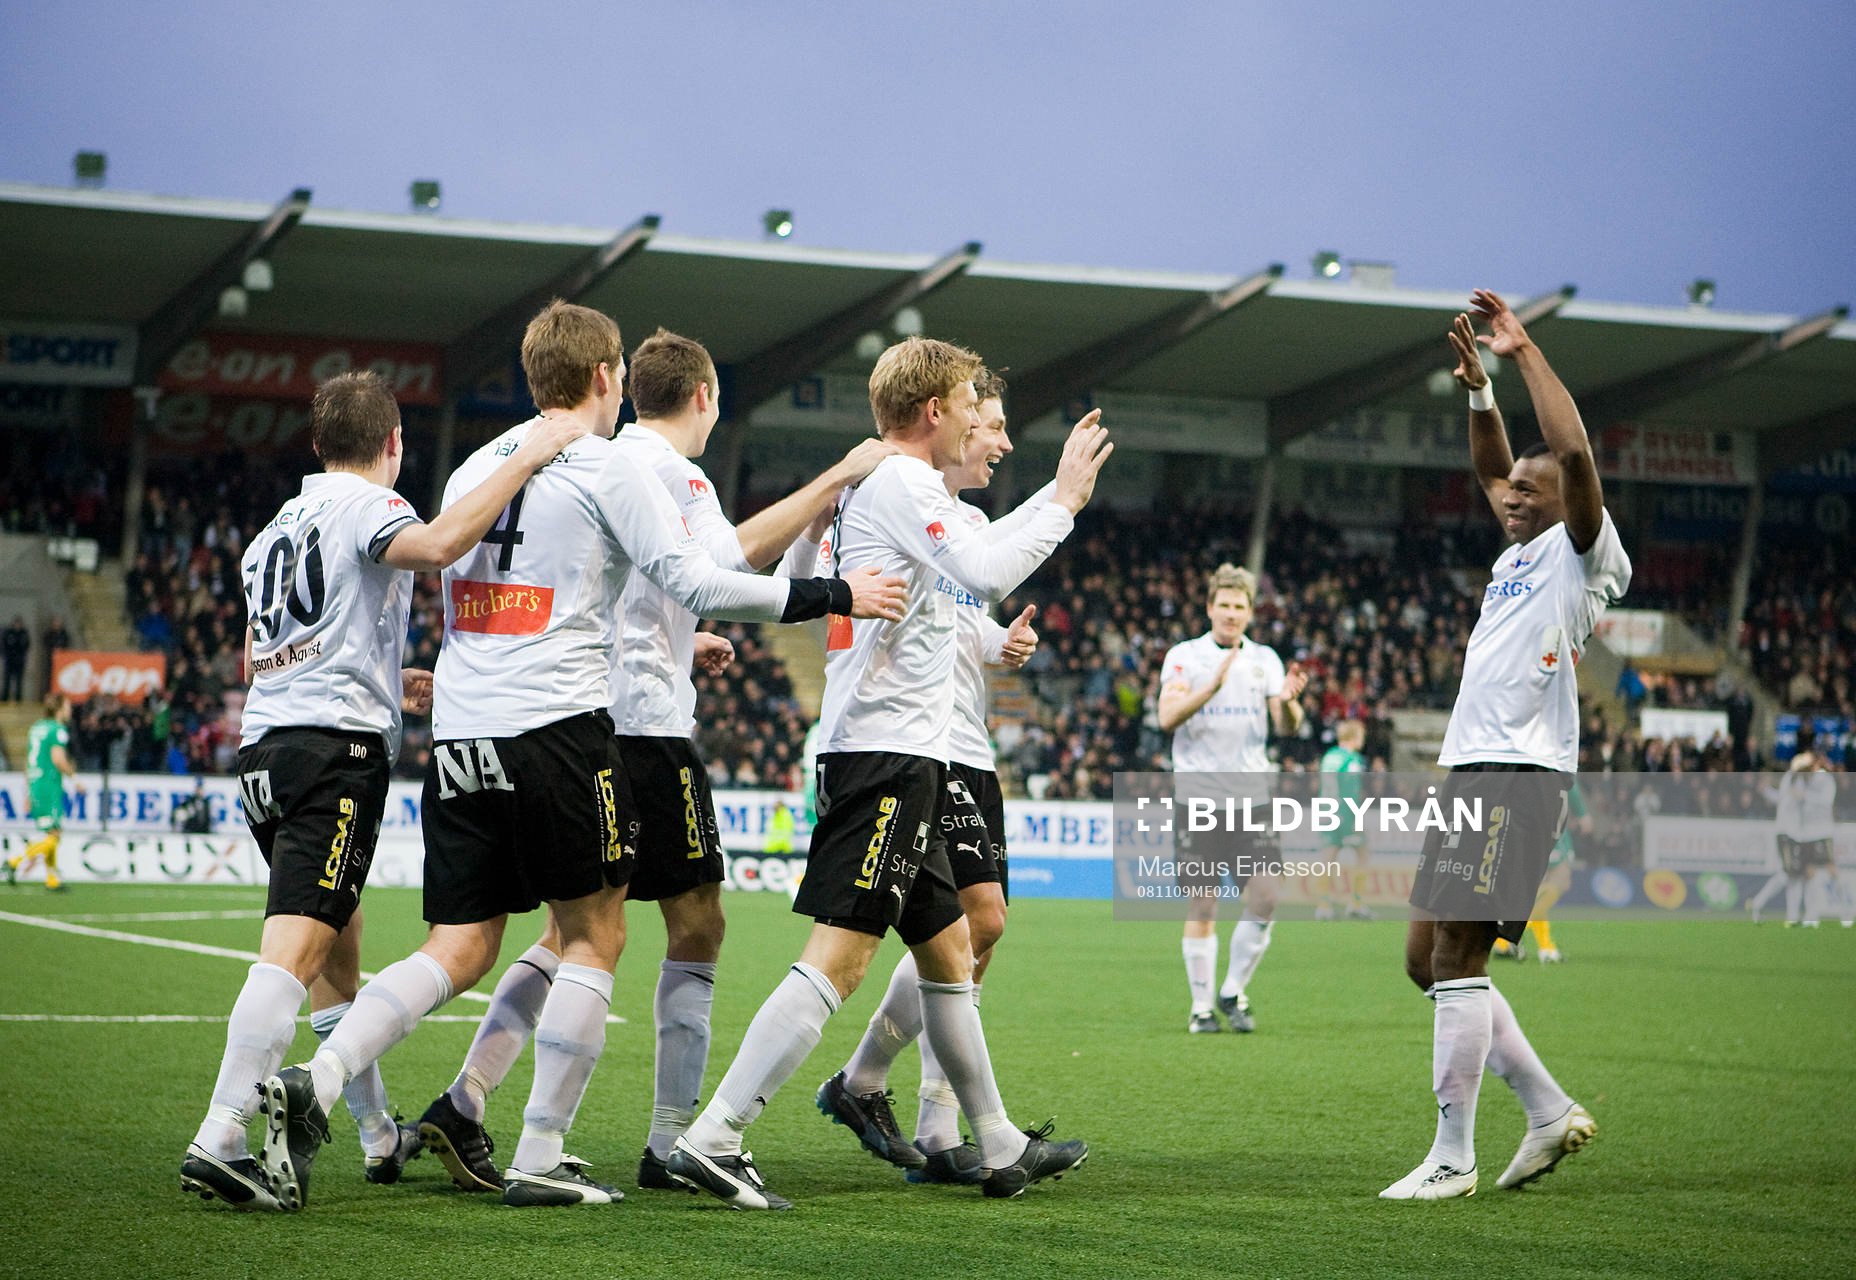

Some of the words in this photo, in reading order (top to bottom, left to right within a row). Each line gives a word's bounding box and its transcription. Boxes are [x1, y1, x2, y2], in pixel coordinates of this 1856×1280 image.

[251, 656, 273, 672] sson
[275, 652, 285, 667] &
[349, 743, 367, 759] 100
